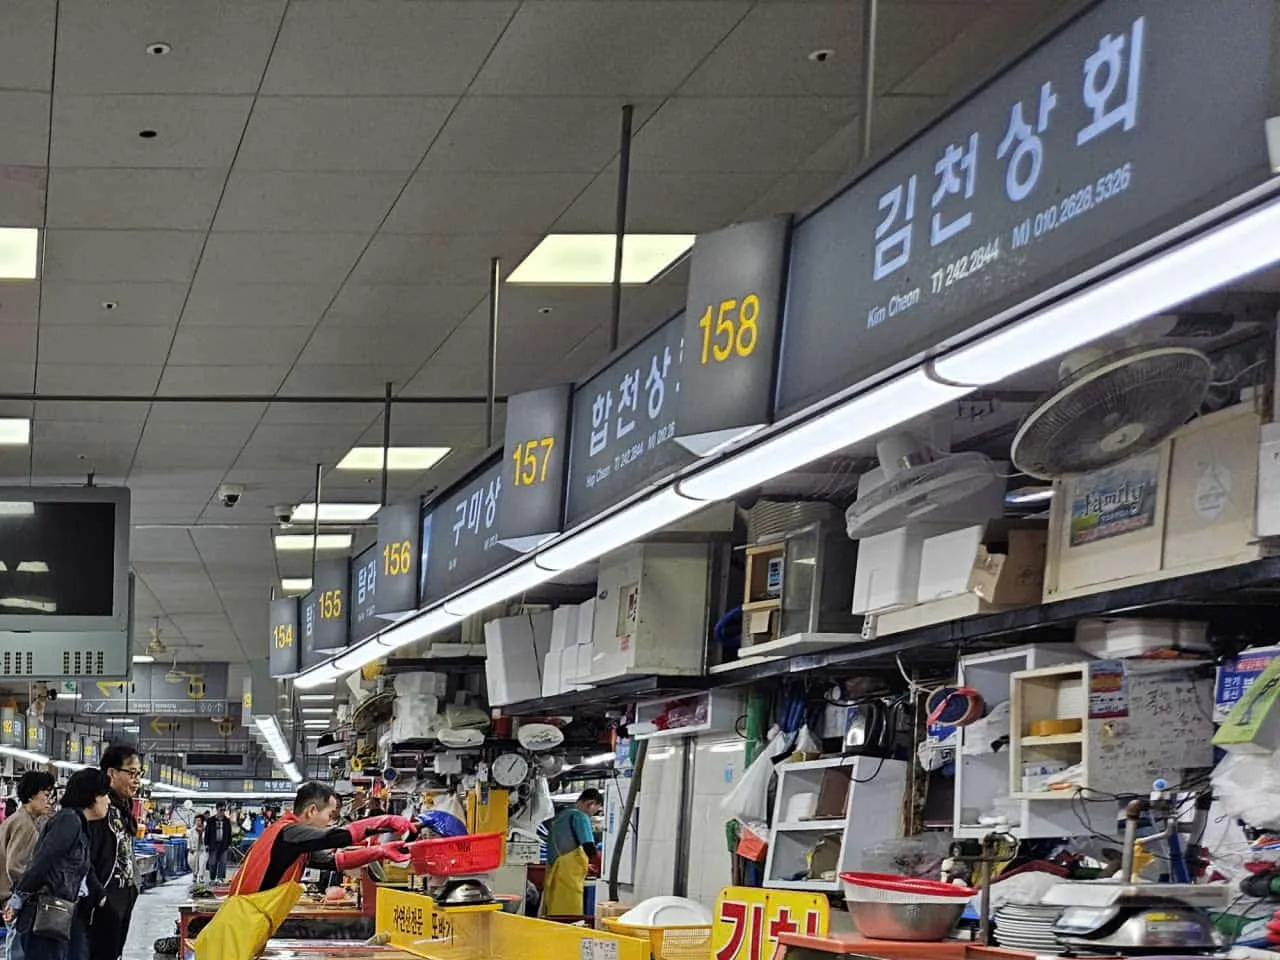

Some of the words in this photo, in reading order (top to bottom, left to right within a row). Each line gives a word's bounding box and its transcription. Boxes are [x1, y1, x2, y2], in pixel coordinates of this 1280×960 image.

[872, 15, 1145, 282] 김천상회
[867, 307, 886, 328] Kim
[888, 287, 921, 318] Cheon
[945, 237, 1000, 287] 242.2844
[1033, 162, 1132, 237] 010.2628.5326
[699, 294, 760, 366] 158
[589, 337, 684, 457] 합천상
[512, 436, 555, 487] 157
[383, 539, 412, 576] 156
[318, 589, 343, 620] 155
[272, 623, 293, 649] 154
